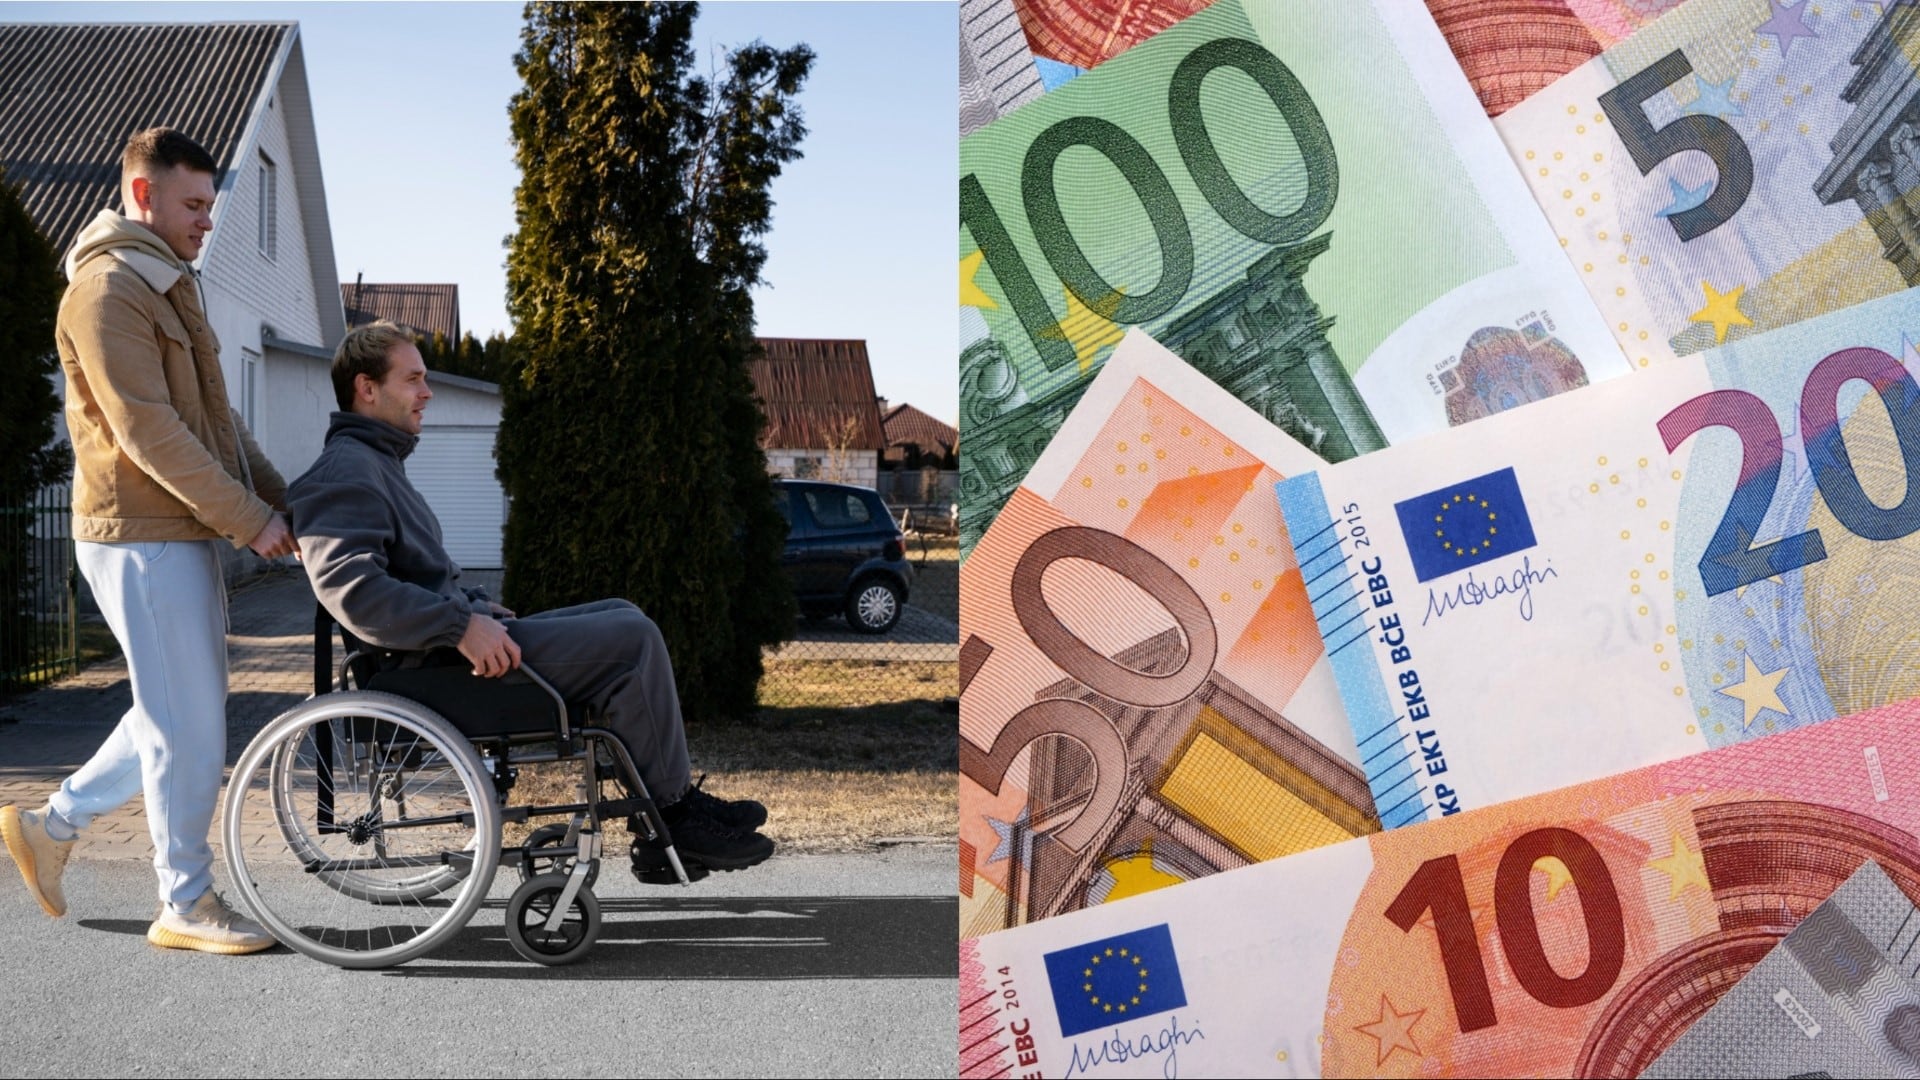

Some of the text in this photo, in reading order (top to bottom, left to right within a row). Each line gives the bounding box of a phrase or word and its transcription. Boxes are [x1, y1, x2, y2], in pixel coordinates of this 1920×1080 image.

[1597, 48, 1754, 243] 5
[959, 37, 1340, 373] 100
[1656, 346, 1920, 598] 20
[1343, 502, 1371, 549] 2015
[1361, 556, 1394, 608] EBC
[959, 526, 1218, 854] 50
[1399, 669, 1431, 722] EKB
[1416, 730, 1448, 777] EKT
[1384, 827, 1626, 1034] 10
[998, 966, 1020, 1011] 2014
[1010, 1018, 1038, 1067] EBC
